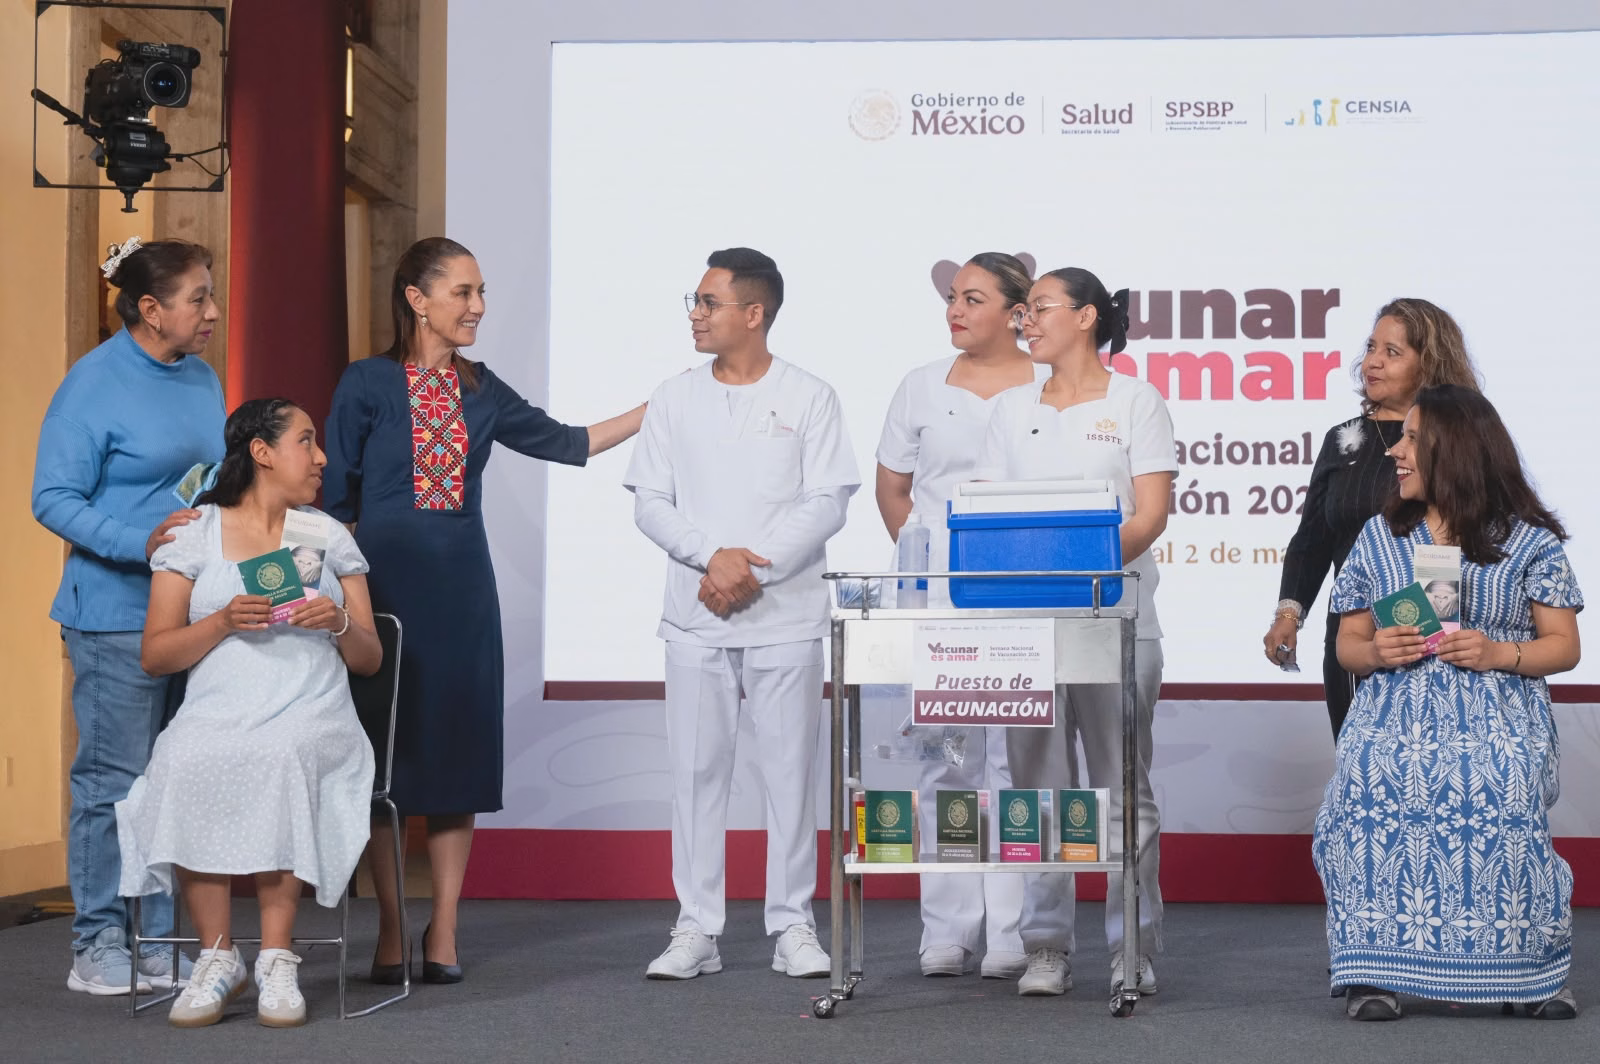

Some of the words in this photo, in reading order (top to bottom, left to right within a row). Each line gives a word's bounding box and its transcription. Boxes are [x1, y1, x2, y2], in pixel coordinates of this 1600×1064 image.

[911, 92, 999, 107] Gobierno
[1004, 92, 1025, 107] de
[1345, 100, 1412, 114] CENSIA
[1061, 103, 1133, 125] Salud
[1165, 101, 1234, 118] SPSBP
[911, 108, 1025, 135] México
[1125, 288, 1341, 341] unar
[1086, 433, 1123, 446] ISSSTE
[1174, 431, 1314, 466] acional
[1248, 485, 1310, 516] 202
[1152, 541, 1174, 564] al
[1185, 544, 1199, 564] 2
[1210, 541, 1242, 564] de
[928, 642, 979, 654] Vacunar
[935, 674, 1003, 690] Puesto
[1009, 673, 1033, 690] de
[920, 698, 1049, 717] VACUNACIÓN
